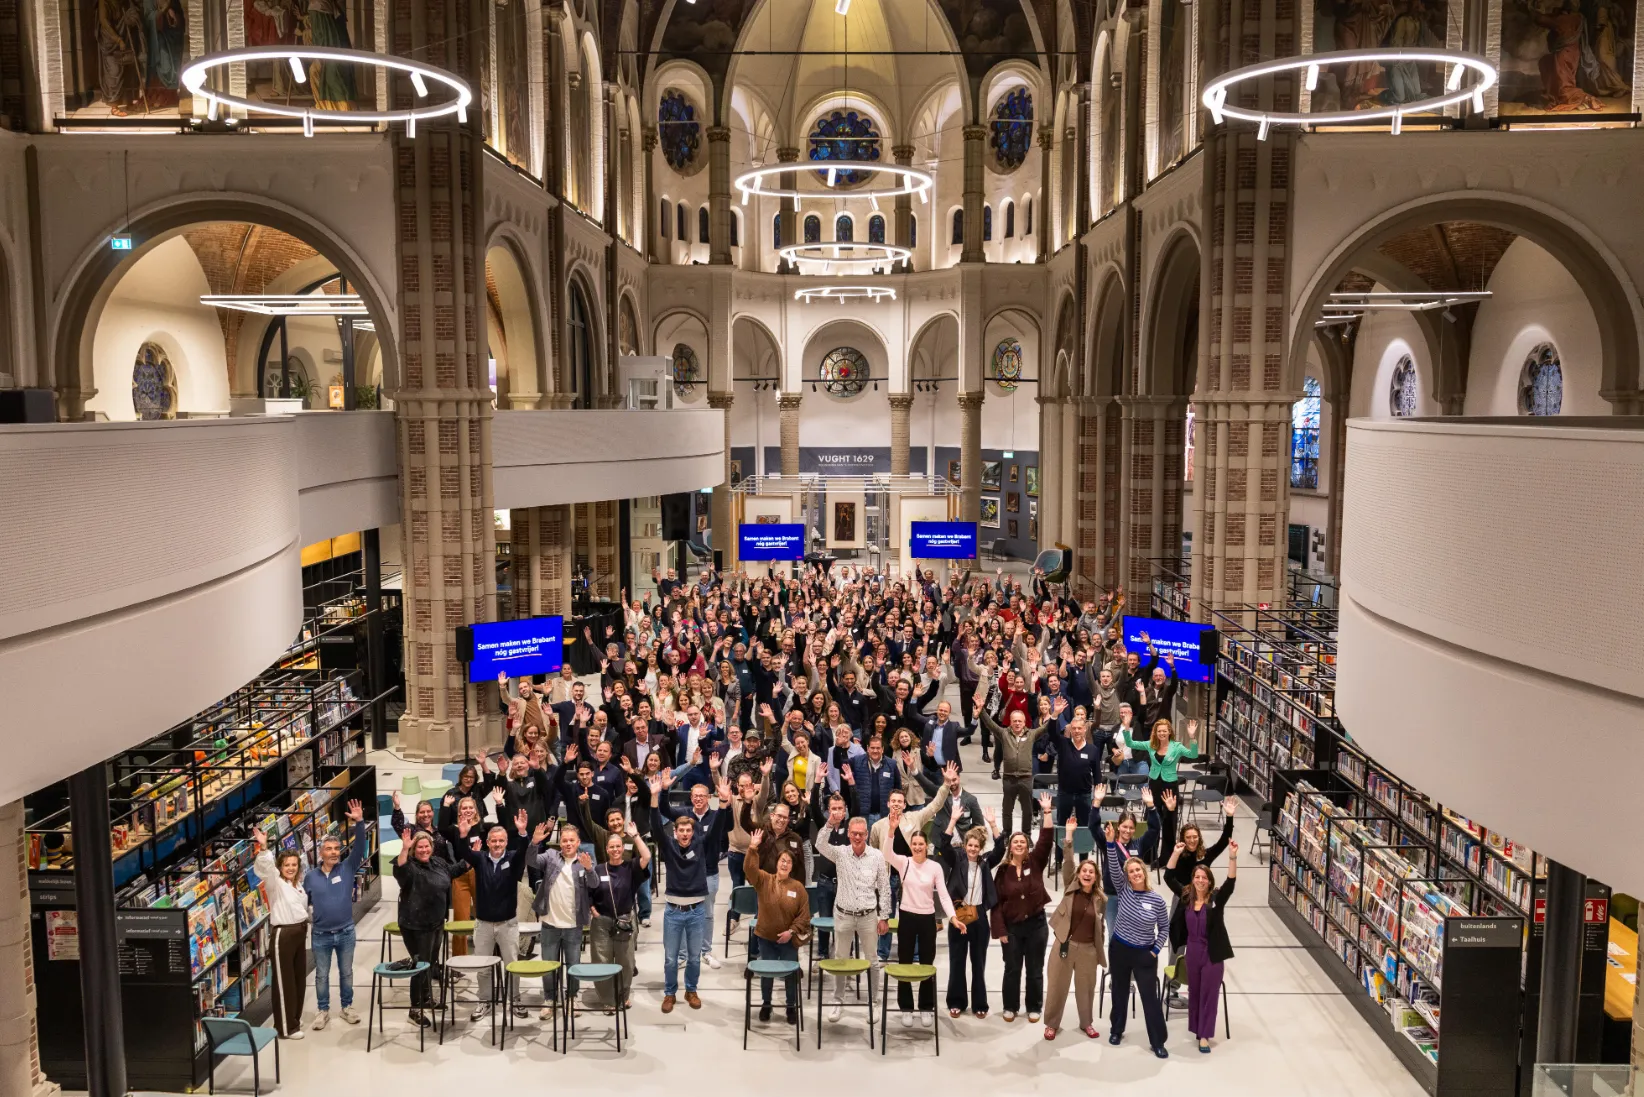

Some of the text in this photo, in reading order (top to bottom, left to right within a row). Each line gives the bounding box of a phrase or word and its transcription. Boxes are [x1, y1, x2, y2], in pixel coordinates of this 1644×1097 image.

[818, 454, 874, 462] VUGHT 1629
[495, 648, 507, 656] nóg
